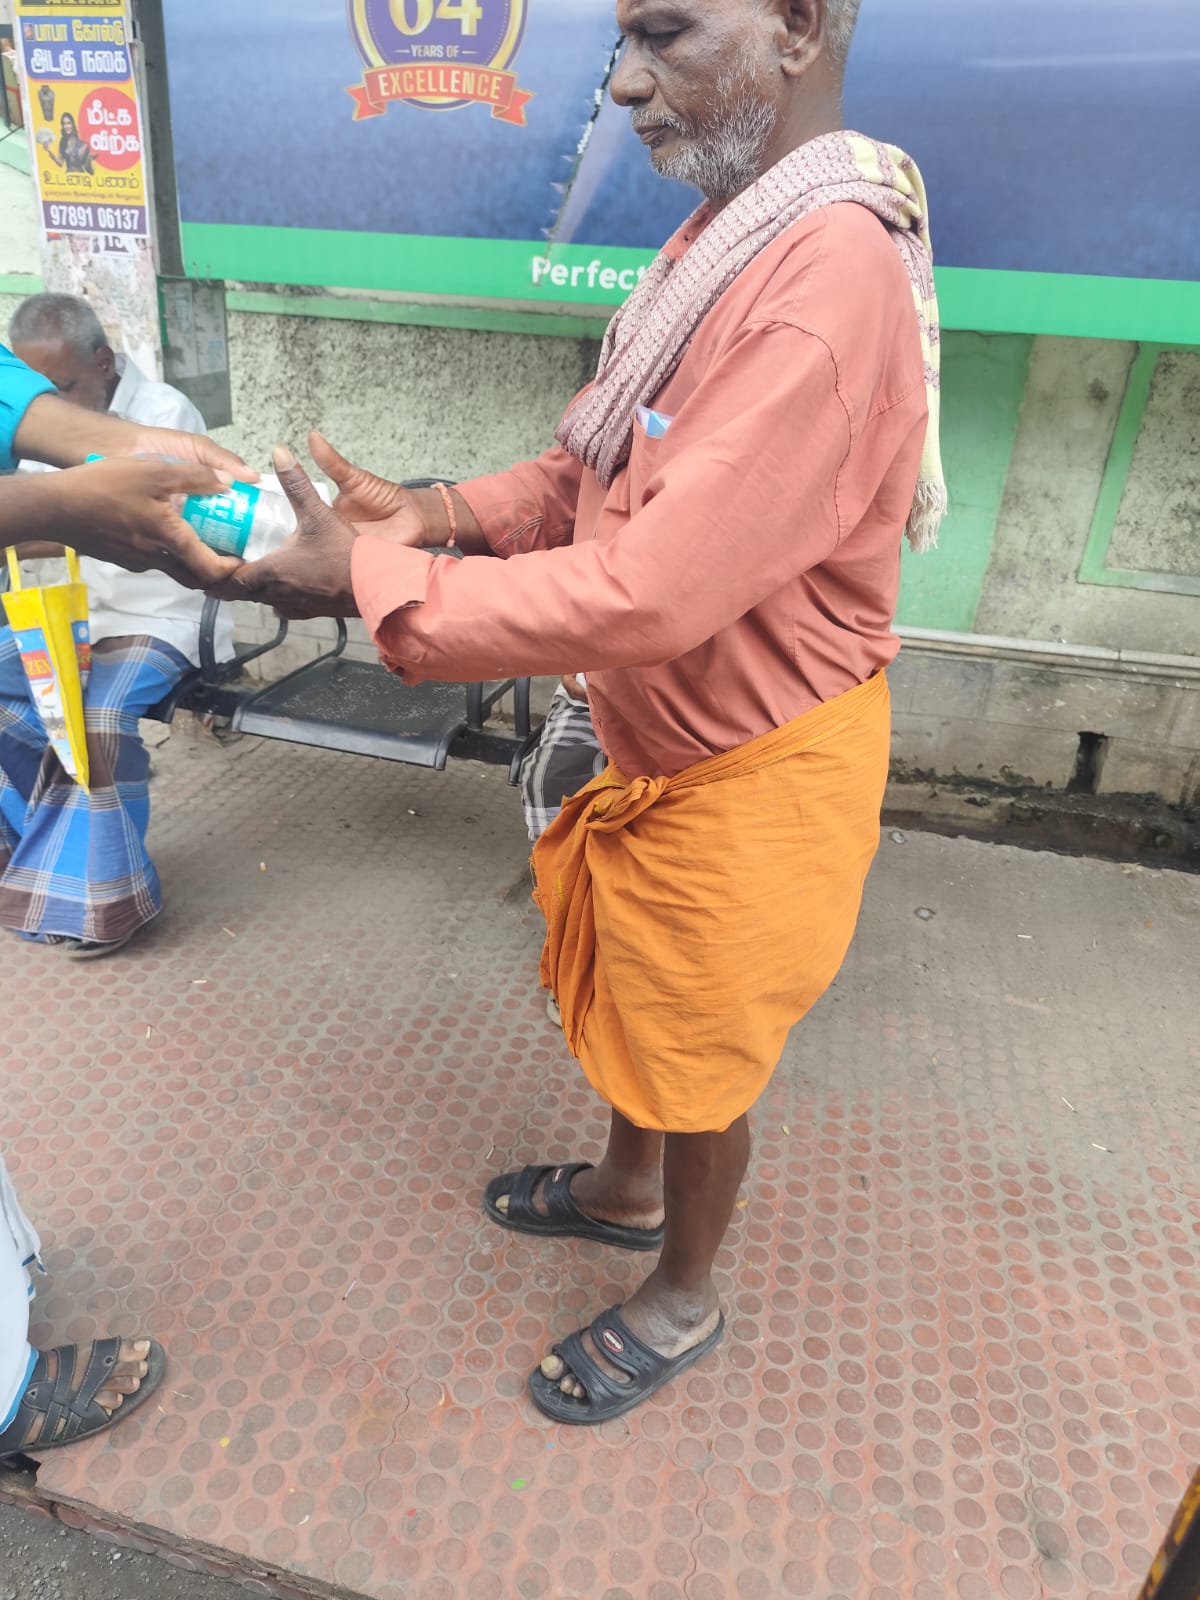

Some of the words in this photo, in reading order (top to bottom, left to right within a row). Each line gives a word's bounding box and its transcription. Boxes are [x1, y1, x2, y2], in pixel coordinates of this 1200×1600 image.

[31, 48, 77, 76] அடகு
[81, 50, 127, 73] நகை
[411, 44, 443, 58] YEARS
[446, 45, 461, 58] OF
[378, 69, 503, 100] EXCELLENCE
[86, 99, 132, 126] மீட்க
[90, 128, 141, 155] விற்க
[96, 173, 140, 189] பணம்
[50, 204, 94, 227] 97891
[97, 207, 139, 230] 06137
